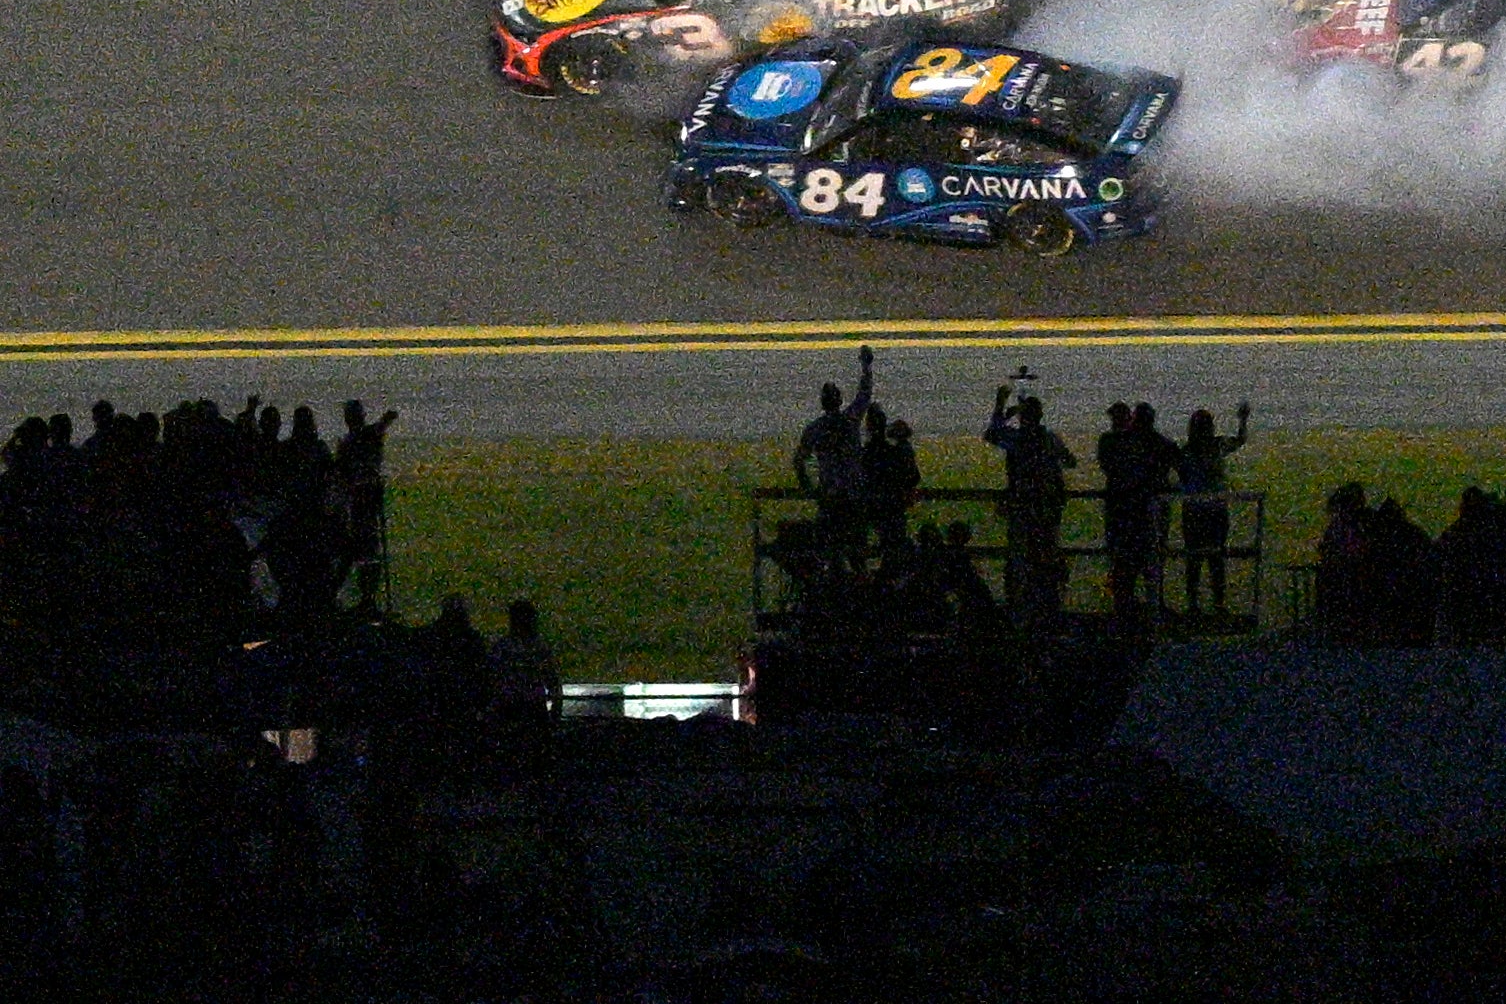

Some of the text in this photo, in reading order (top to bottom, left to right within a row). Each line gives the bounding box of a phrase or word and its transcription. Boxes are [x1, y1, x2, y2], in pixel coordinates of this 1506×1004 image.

[649, 13, 736, 62] 3
[892, 47, 1021, 106] 84
[800, 168, 886, 218] 84
[942, 176, 1087, 200] CARVANA
